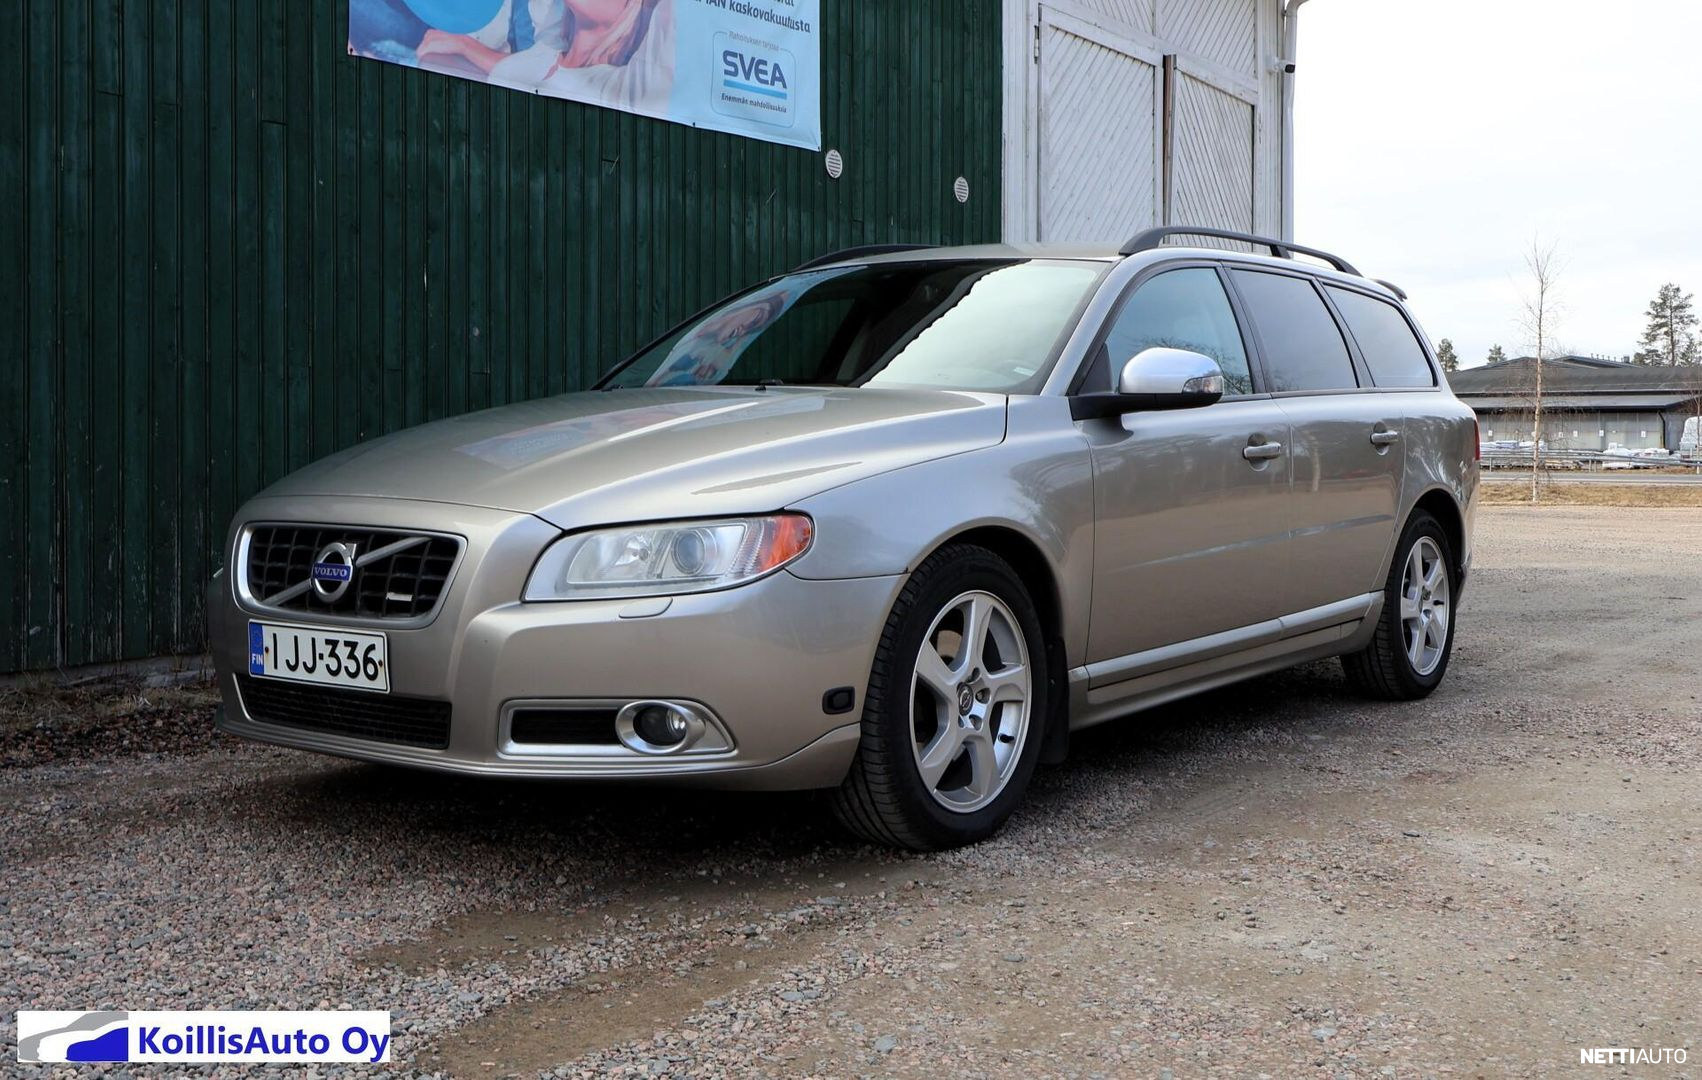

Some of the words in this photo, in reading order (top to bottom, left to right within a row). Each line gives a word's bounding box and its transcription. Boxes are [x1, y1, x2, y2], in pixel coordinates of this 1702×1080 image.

[729, 0, 811, 33] kaskovakuutusta
[722, 50, 787, 89] SVEA
[314, 567, 348, 578] VOLVO
[251, 653, 264, 666] FIN
[272, 632, 379, 681] IJJ-336
